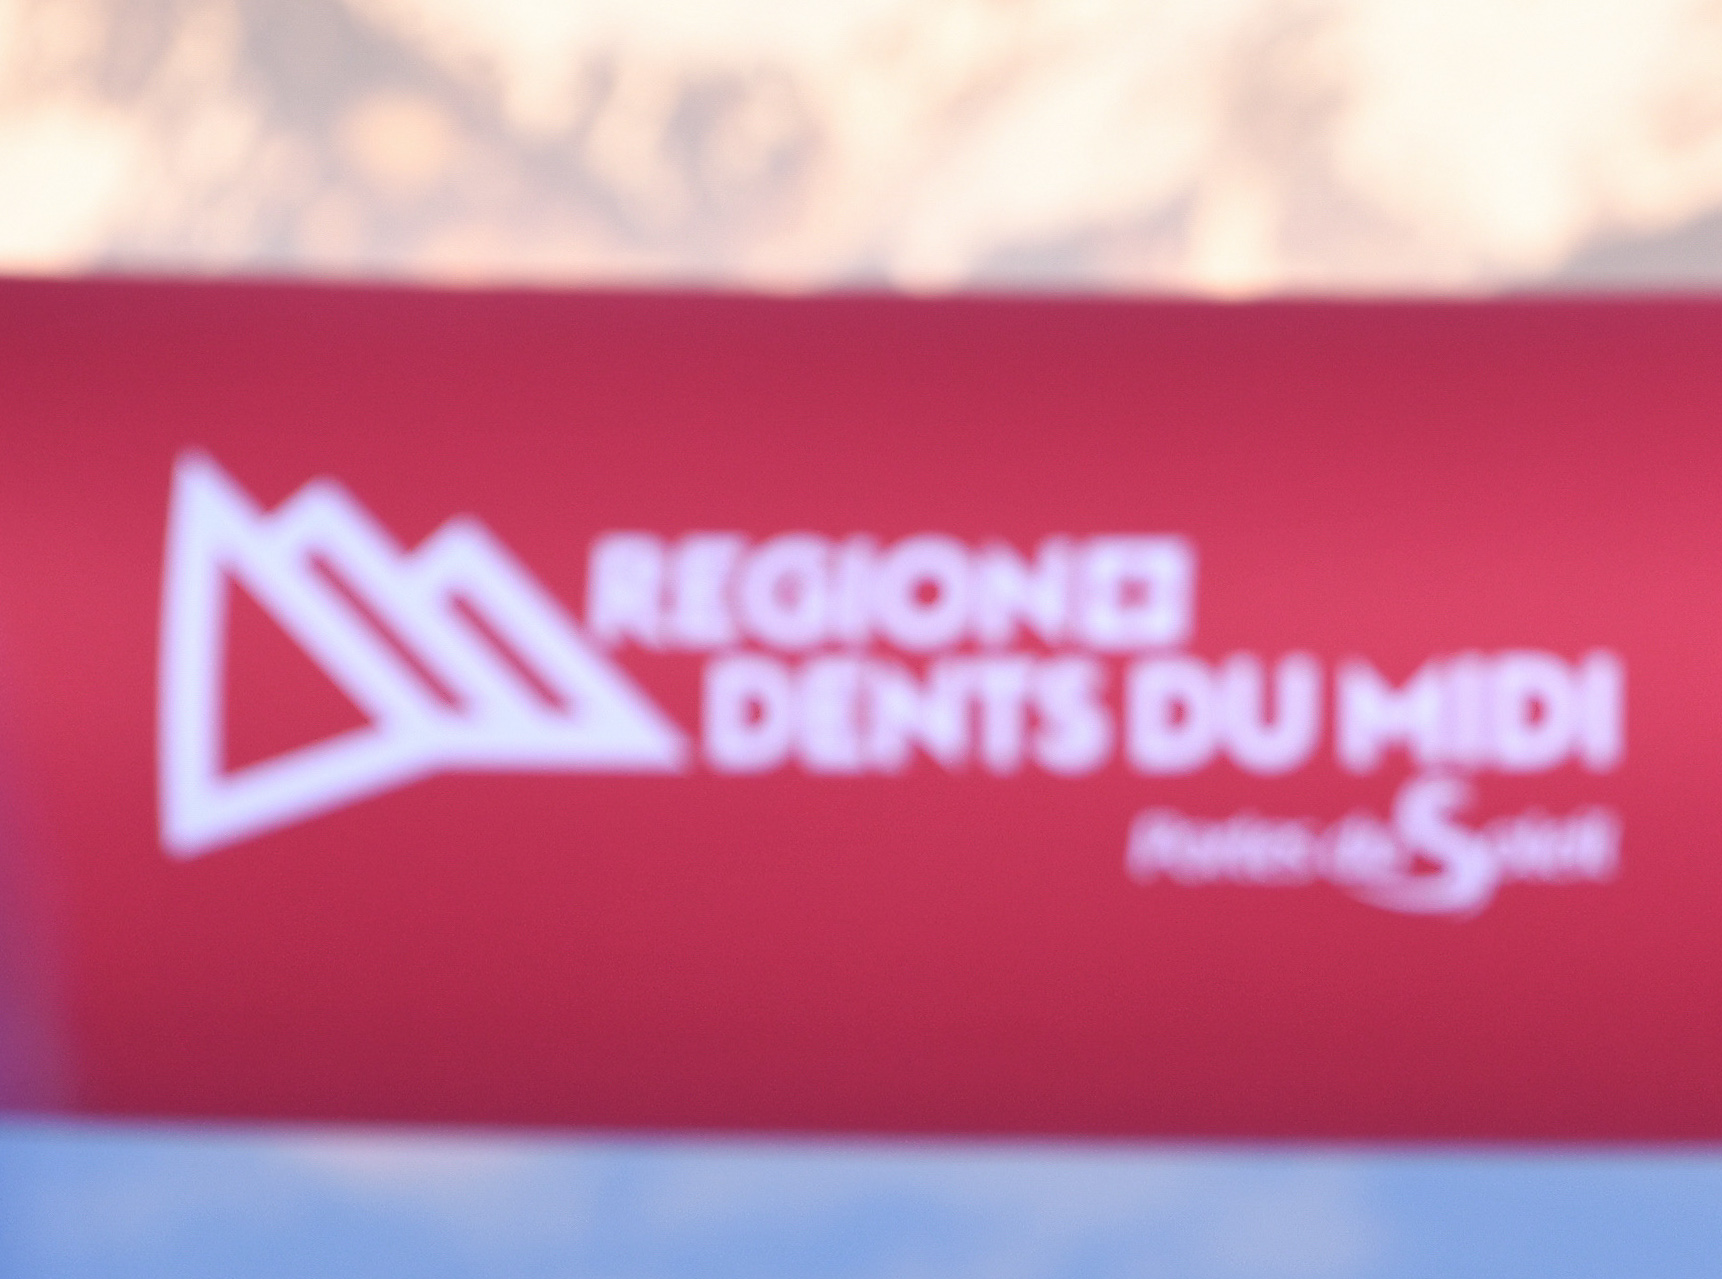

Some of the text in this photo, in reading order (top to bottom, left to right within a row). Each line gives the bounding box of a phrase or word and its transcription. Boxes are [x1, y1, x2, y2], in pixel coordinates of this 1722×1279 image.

[588, 533, 1068, 651] REGION
[704, 650, 1624, 774] DENTS DU MIDI
